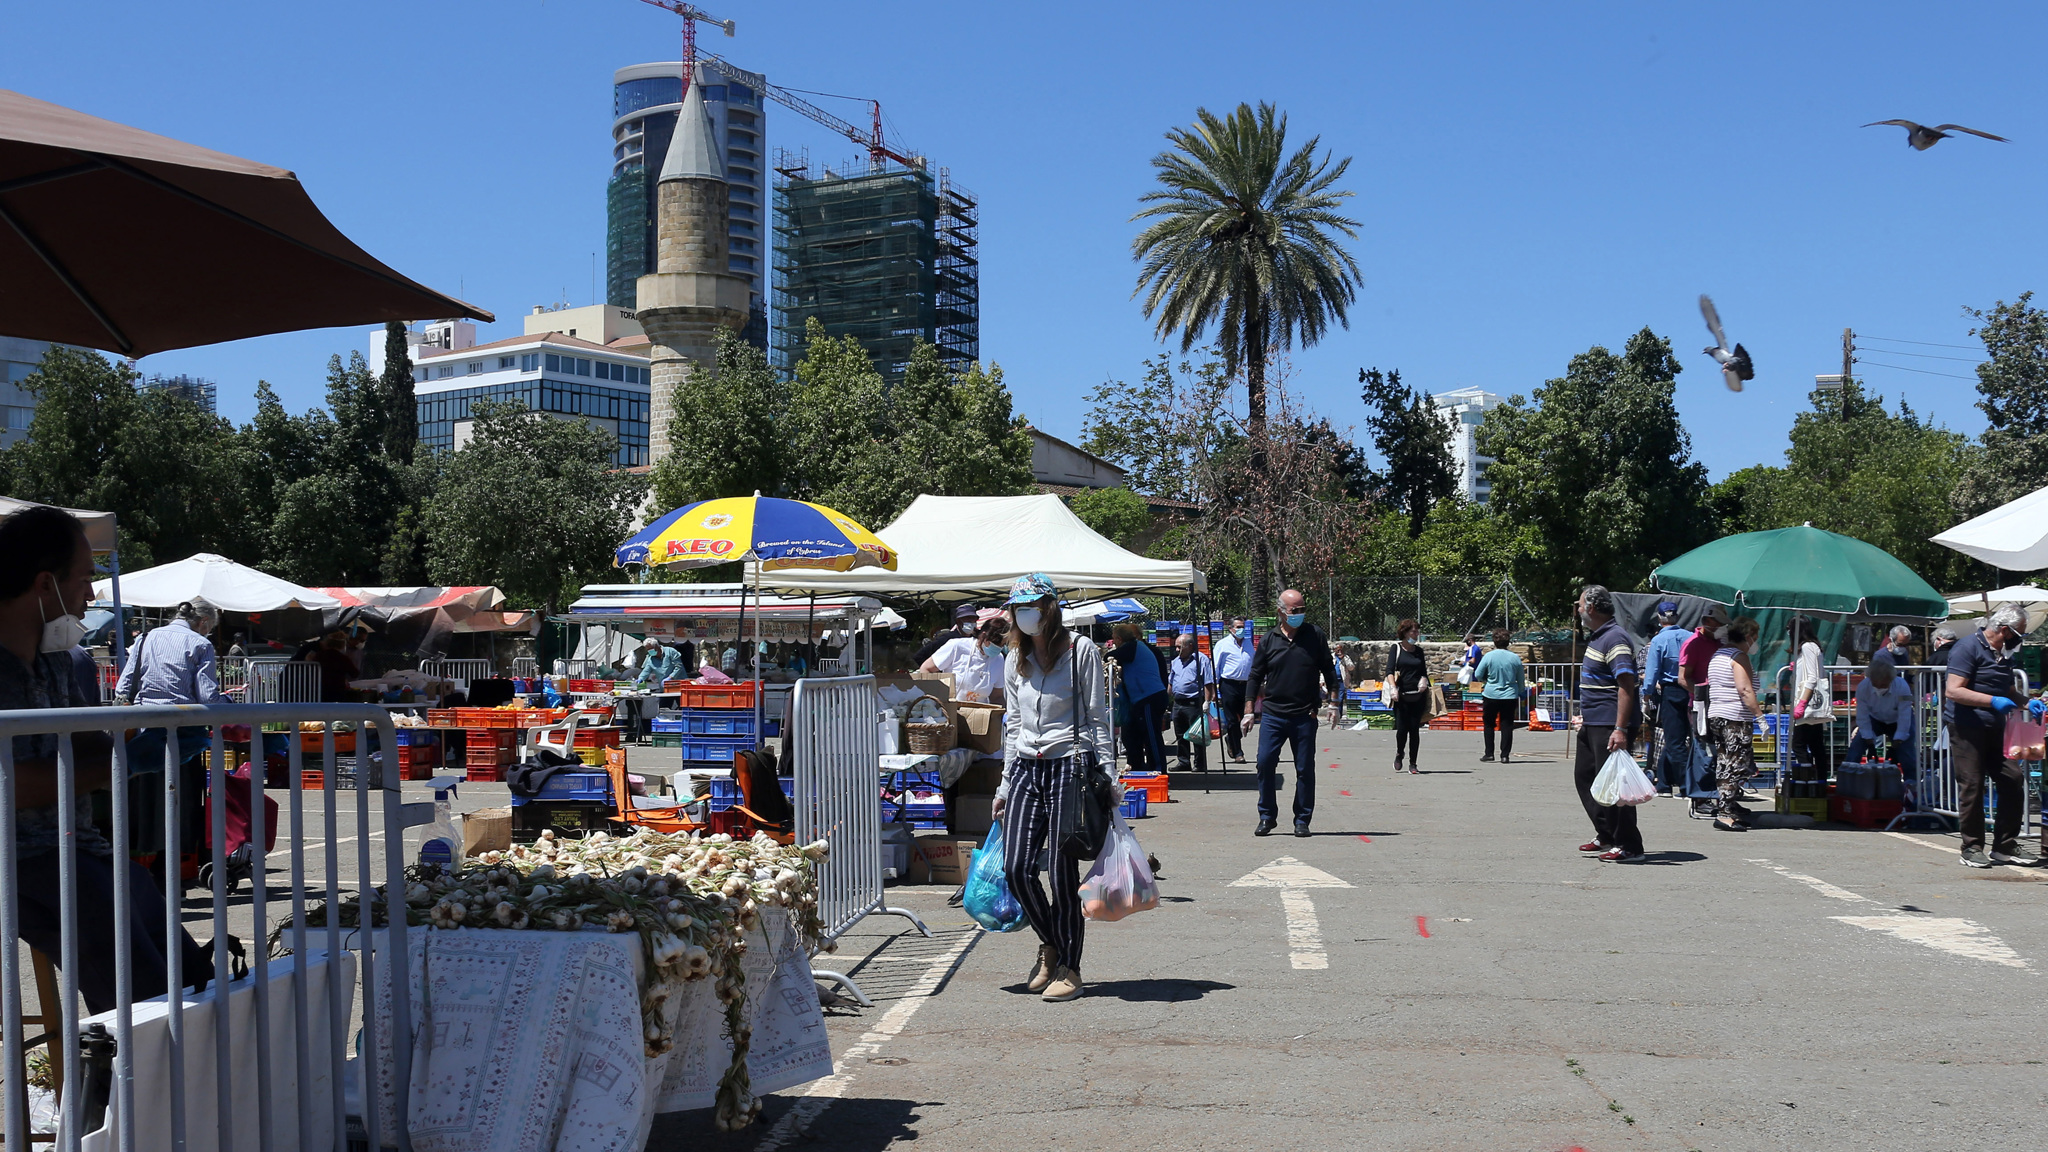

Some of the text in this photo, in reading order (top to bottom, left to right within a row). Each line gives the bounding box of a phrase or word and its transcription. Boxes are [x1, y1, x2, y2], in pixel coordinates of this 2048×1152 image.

[666, 539, 735, 557] KEO
[757, 539, 789, 548] Brewed
[802, 538, 815, 546] the
[816, 539, 846, 549] Island
[786, 547, 823, 556] of Cyprus
